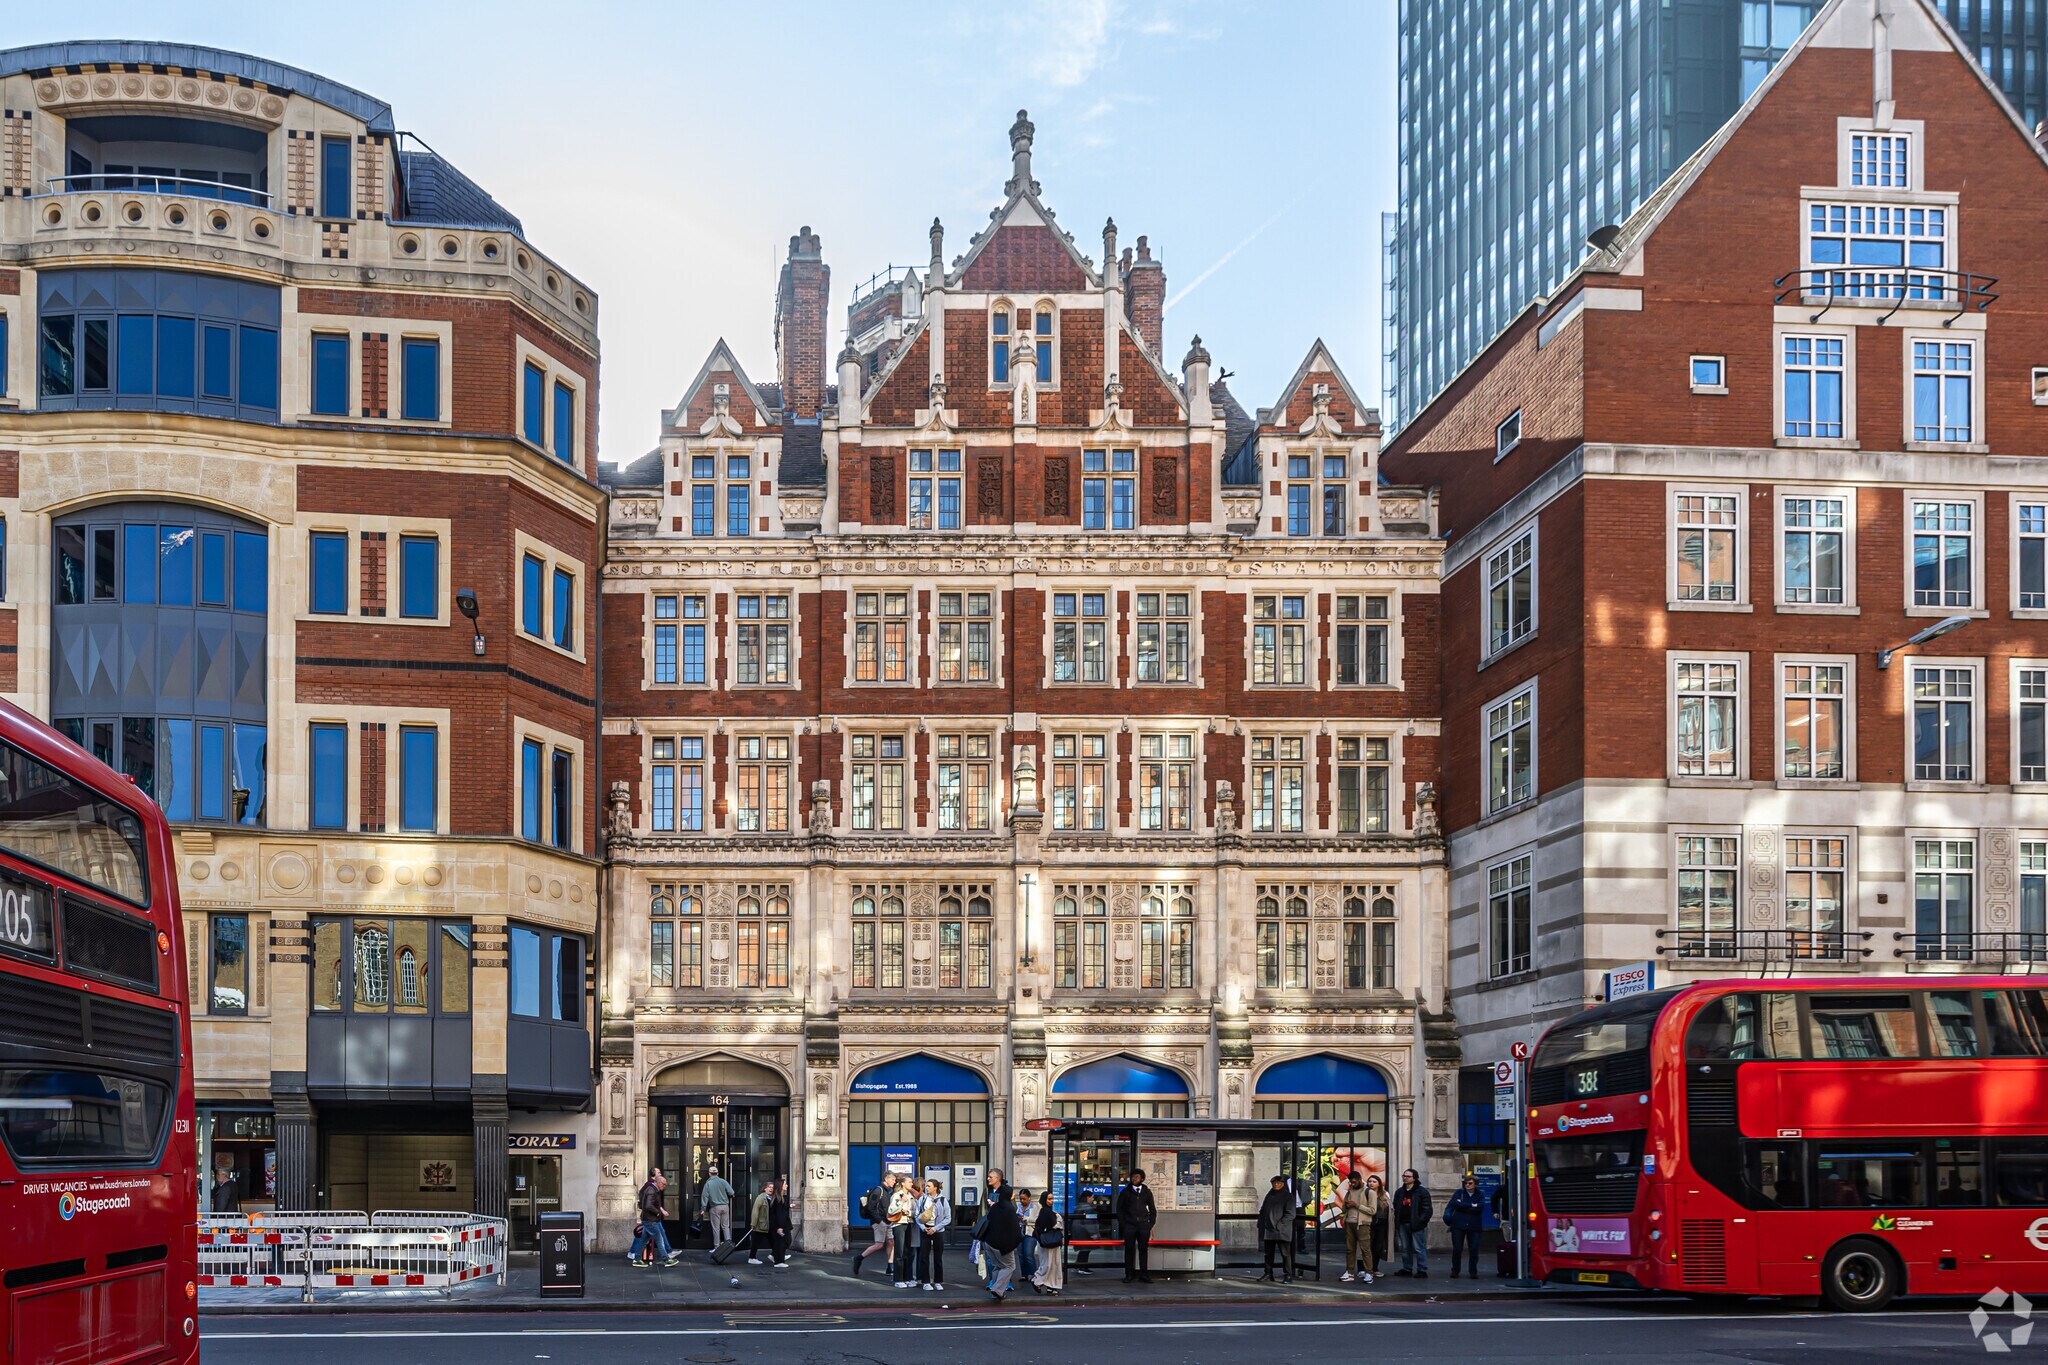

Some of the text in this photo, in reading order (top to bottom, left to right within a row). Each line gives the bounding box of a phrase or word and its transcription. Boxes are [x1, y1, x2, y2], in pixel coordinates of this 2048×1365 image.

[677, 557, 1403, 576] FIRE BRIGADE STATION
[1613, 969, 1645, 983] TESCO
[1613, 983, 1645, 996] express
[1515, 1043, 1526, 1056] K
[855, 1083, 888, 1091] Bishopsgate
[710, 1095, 730, 1106] 164
[175, 1119, 190, 1133] 12311
[1568, 1113, 1614, 1128] Stagecoach
[507, 1135, 560, 1148] CORAL
[603, 1162, 630, 1178] 164
[808, 1166, 836, 1180] 164
[23, 1178, 151, 1195] DRIVER VACANCIES www.busdrivers.london
[76, 1193, 131, 1215] Stagecoach
[1581, 1230, 1627, 1241] WHITE FOX
